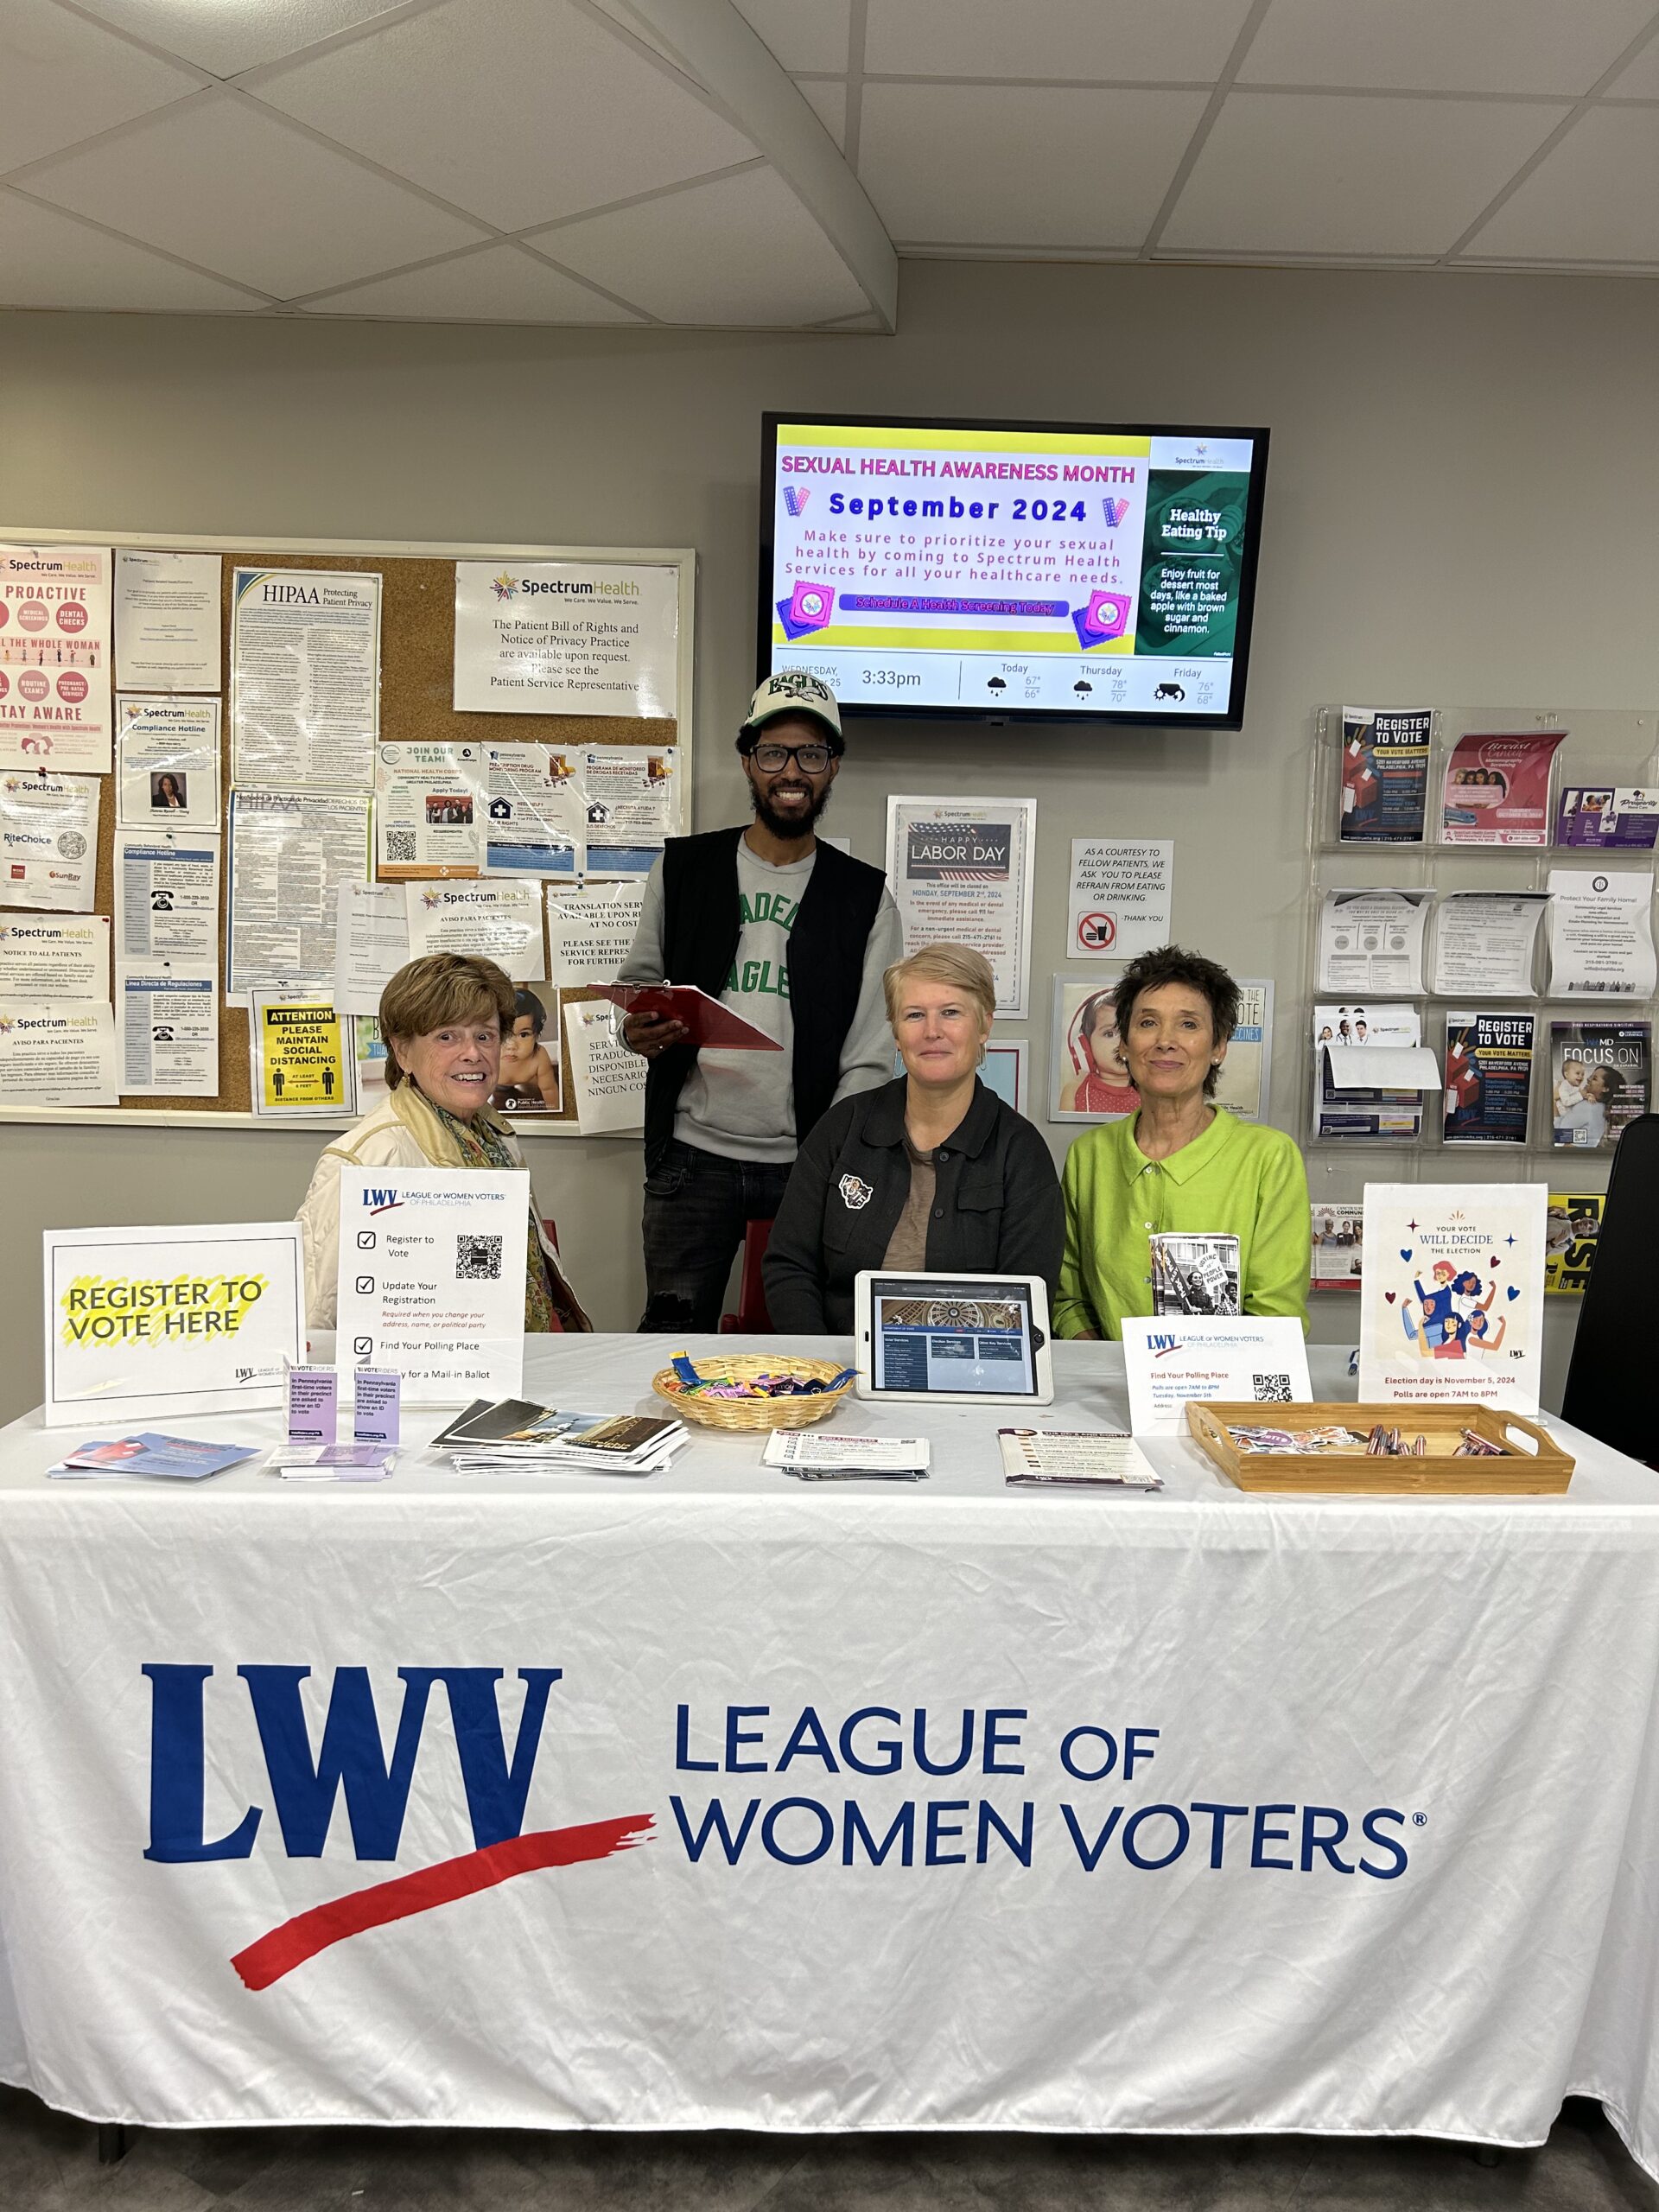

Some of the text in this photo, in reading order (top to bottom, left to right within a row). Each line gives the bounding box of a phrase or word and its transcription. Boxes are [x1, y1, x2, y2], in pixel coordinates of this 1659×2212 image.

[781, 456, 1135, 483] SEXUAL HEALTH AWARENESS MONTH
[830, 493, 1086, 522] September 2024
[1170, 509, 1221, 524] Healthy
[1161, 525, 1227, 541] Eating Tip
[804, 531, 1114, 550] Make sure to prioritize your sexual
[796, 547, 1121, 567] health by coming to Spectrum Health
[785, 563, 1122, 583] Services for all your healthcare needs.
[1161, 569, 1220, 580] Enjoy fruit for
[522, 579, 639, 596] SpectrumHealth
[1161, 580, 1218, 590] dessert most
[6, 586, 86, 601] PROACTIVE
[263, 584, 321, 604] HIPAA
[323, 588, 358, 599] Protecting
[1151, 591, 1173, 601] days,
[1176, 591, 1190, 601] like
[1200, 592, 1227, 601] baked
[323, 598, 372, 608] Patient Privacy
[1151, 602, 1224, 613] apple with brown
[1166, 613, 1208, 623] sugar and
[493, 620, 639, 633] The Patient Bill of Rights and
[1165, 624, 1210, 633] cinnamon.
[10, 639, 99, 650] THE WHOLE WOMAN
[501, 634, 629, 648] Notice of Privacy Practice
[499, 650, 630, 663] are available upon request.
[531, 664, 562, 674] Please
[584, 665, 599, 675] the
[1001, 663, 1028, 675] Today
[1080, 664, 1122, 677] Thursday
[1173, 667, 1201, 679] Friday
[490, 677, 639, 691] Patient Service Representative
[862, 670, 921, 687] 3:33pm
[34, 706, 82, 721] AWARE
[1376, 717, 1429, 730] REGISTER
[1376, 731, 1422, 743] TO VOTE
[912, 846, 1005, 861] LABOR DAY
[1112, 860, 1149, 868] PATIENTS,
[270, 1011, 332, 1021] ATTENTION
[1478, 1020, 1532, 1033] REGISTER
[1478, 1033, 1524, 1046] TO VOTE
[270, 1056, 335, 1065] DISTANCING
[1564, 1048, 1639, 1064] FOCUS ON
[589, 1059, 646, 1073] DISPONIBLE
[387, 1236, 423, 1244] Register
[1421, 1236, 1493, 1244] WILL DECIDE
[383, 1282, 415, 1292] Update
[70, 1281, 262, 1310] REGISTER TO
[383, 1296, 435, 1306] Registration
[68, 1310, 239, 1339] VOTE HERE
[424, 1342, 454, 1351] Polling
[1419, 1377, 1433, 1386] day
[677, 1705, 1160, 1781] LEAGUE OF
[142, 1663, 563, 1864] LWV
[671, 1796, 1034, 1867] WOMEN
